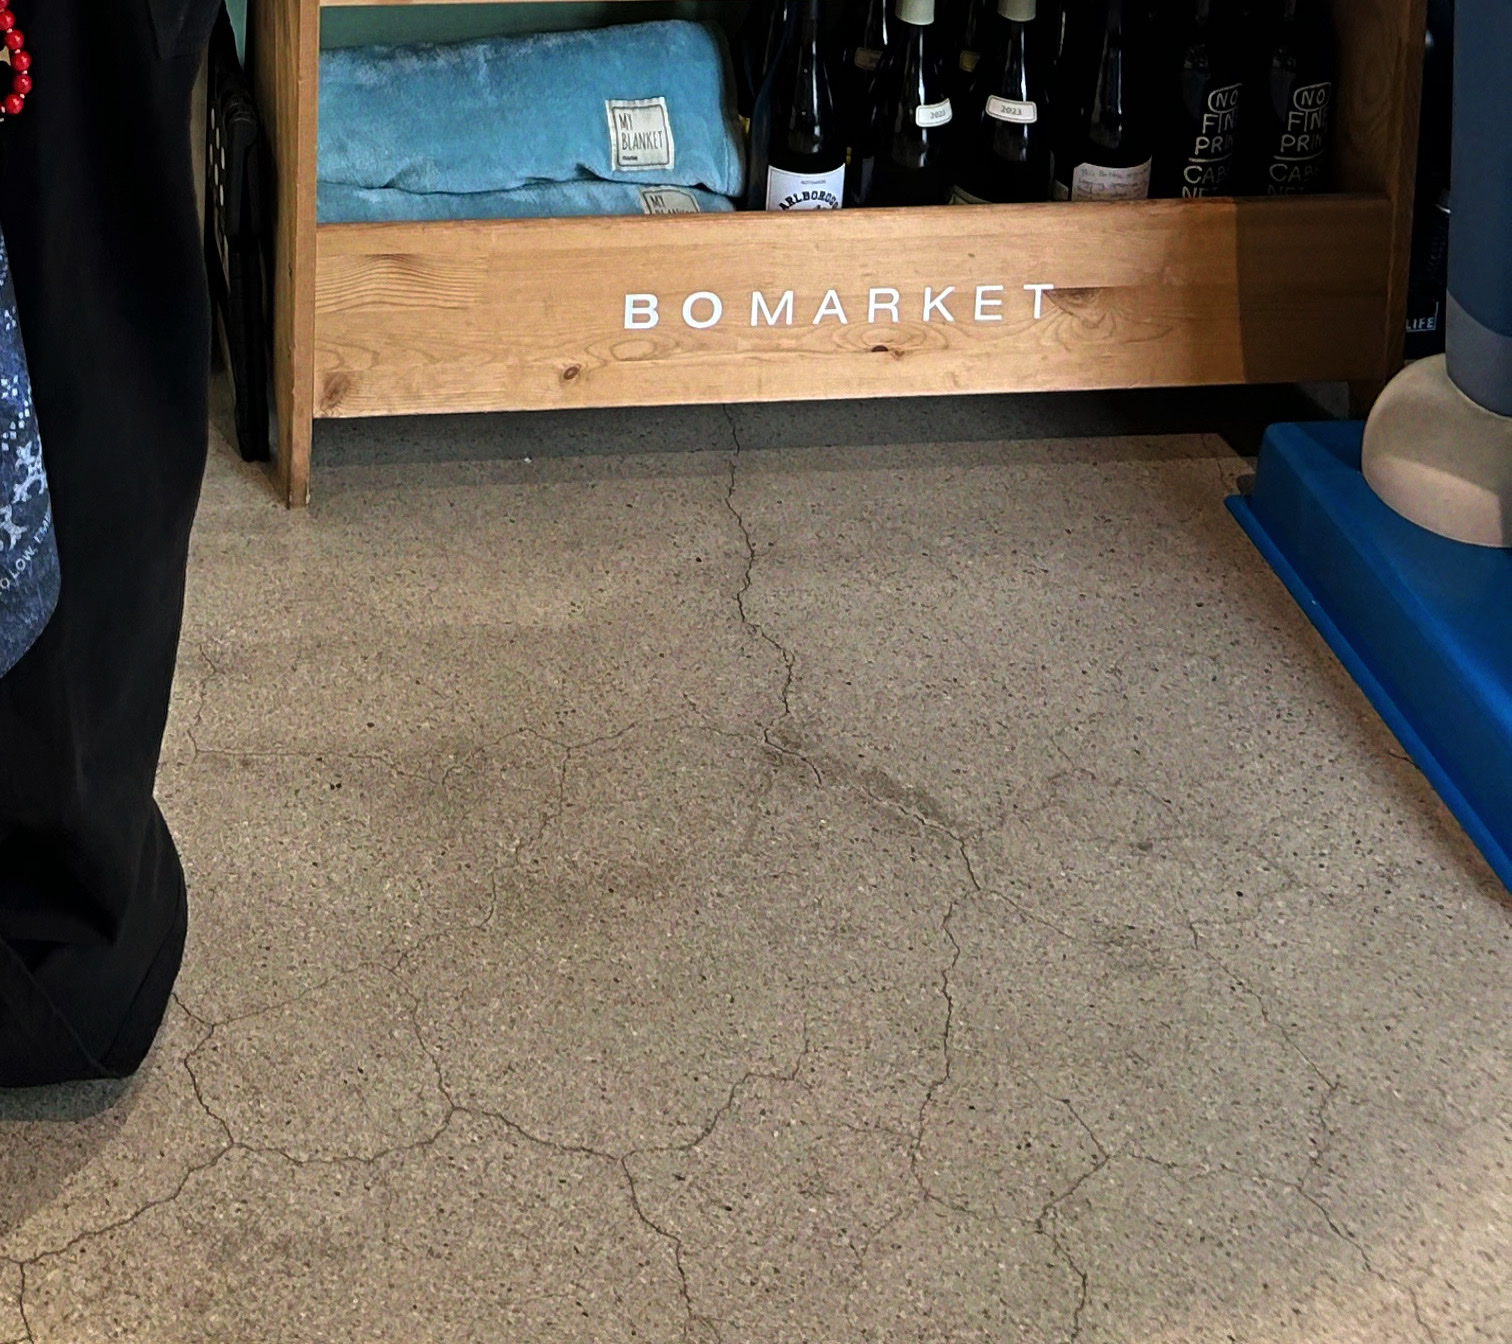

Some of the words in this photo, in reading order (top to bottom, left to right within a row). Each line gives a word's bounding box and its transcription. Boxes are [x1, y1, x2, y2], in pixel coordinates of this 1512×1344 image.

[1215, 88, 1239, 109] NO
[1301, 89, 1327, 109] NO
[1000, 105, 1023, 116] 2023
[618, 113, 634, 132] MY
[1201, 111, 1240, 135] FIN
[620, 129, 664, 151] BLANKET
[649, 194, 665, 209] MY
[750, 283, 1055, 327] MARKET
